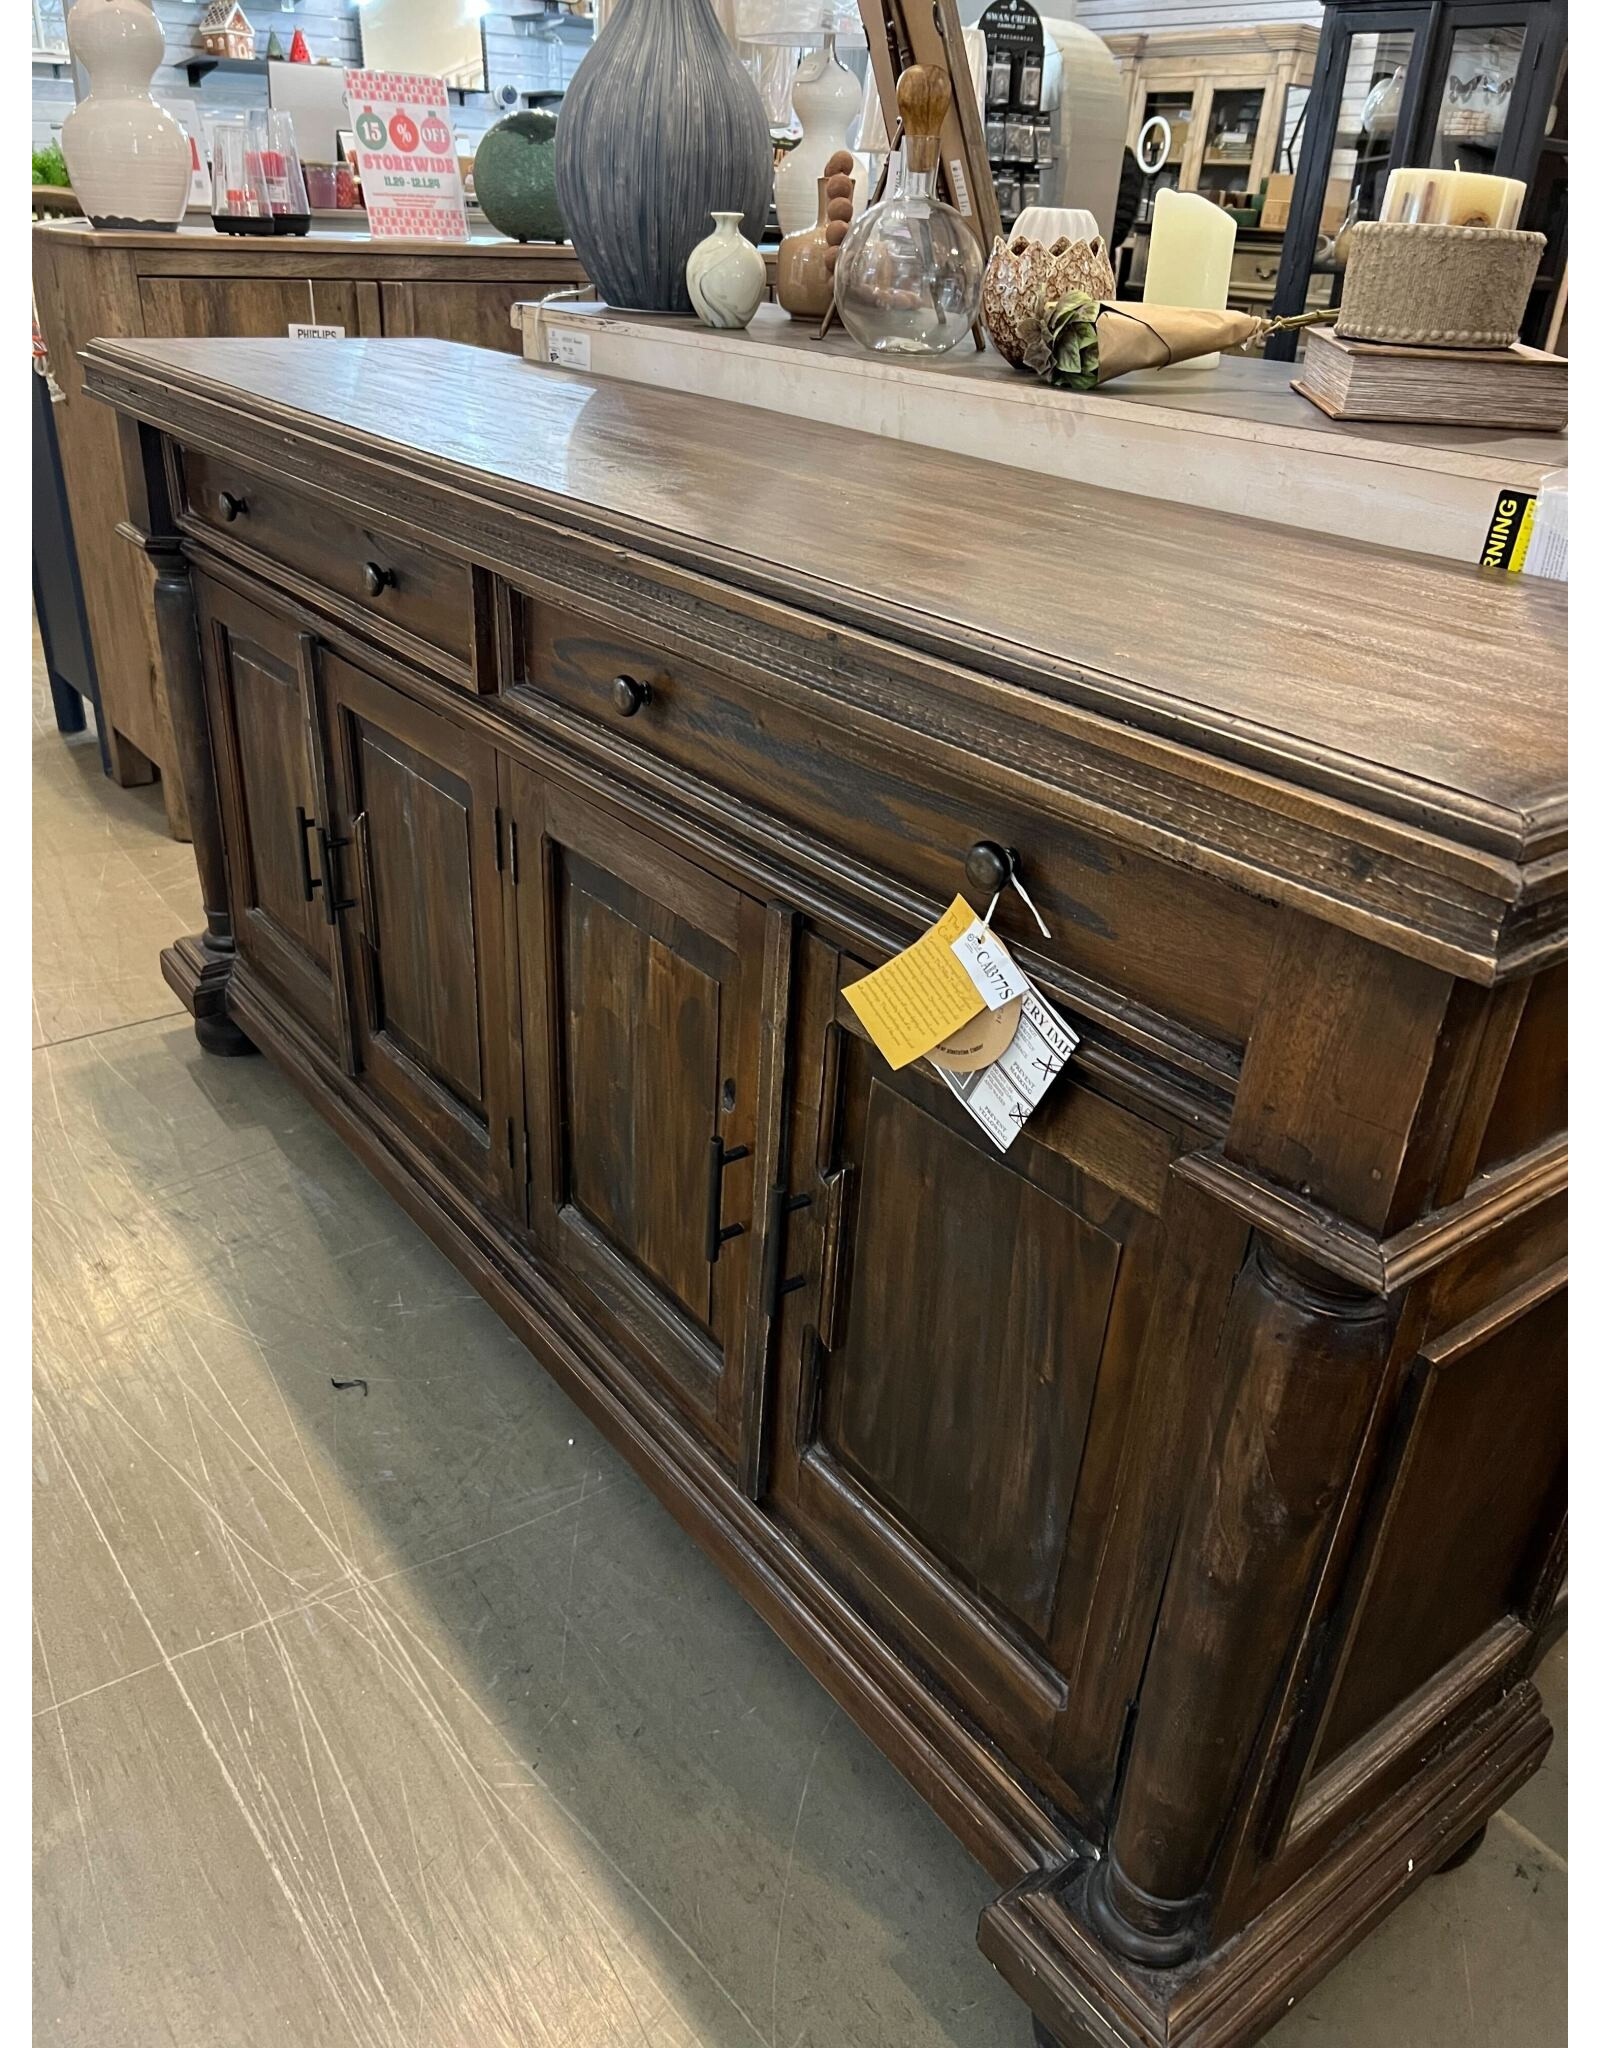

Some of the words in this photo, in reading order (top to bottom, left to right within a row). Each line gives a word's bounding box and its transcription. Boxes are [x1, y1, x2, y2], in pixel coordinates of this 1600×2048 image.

[986, 11, 1009, 22] SWAN
[1010, 14, 1038, 25] CREEK
[362, 121, 381, 142] 15
[421, 127, 449, 143] OFF
[363, 154, 455, 174] STOREWIDE
[1483, 499, 1518, 567] RNING
[976, 951, 1014, 1000] CAB77S
[1023, 997, 1049, 1027] ERY
[1009, 1066, 1032, 1095] MARKING
[1012, 1061, 1036, 1089] PREVENT
[979, 1107, 1008, 1141] YELLOWING
[984, 1106, 1007, 1132] PREVENT
